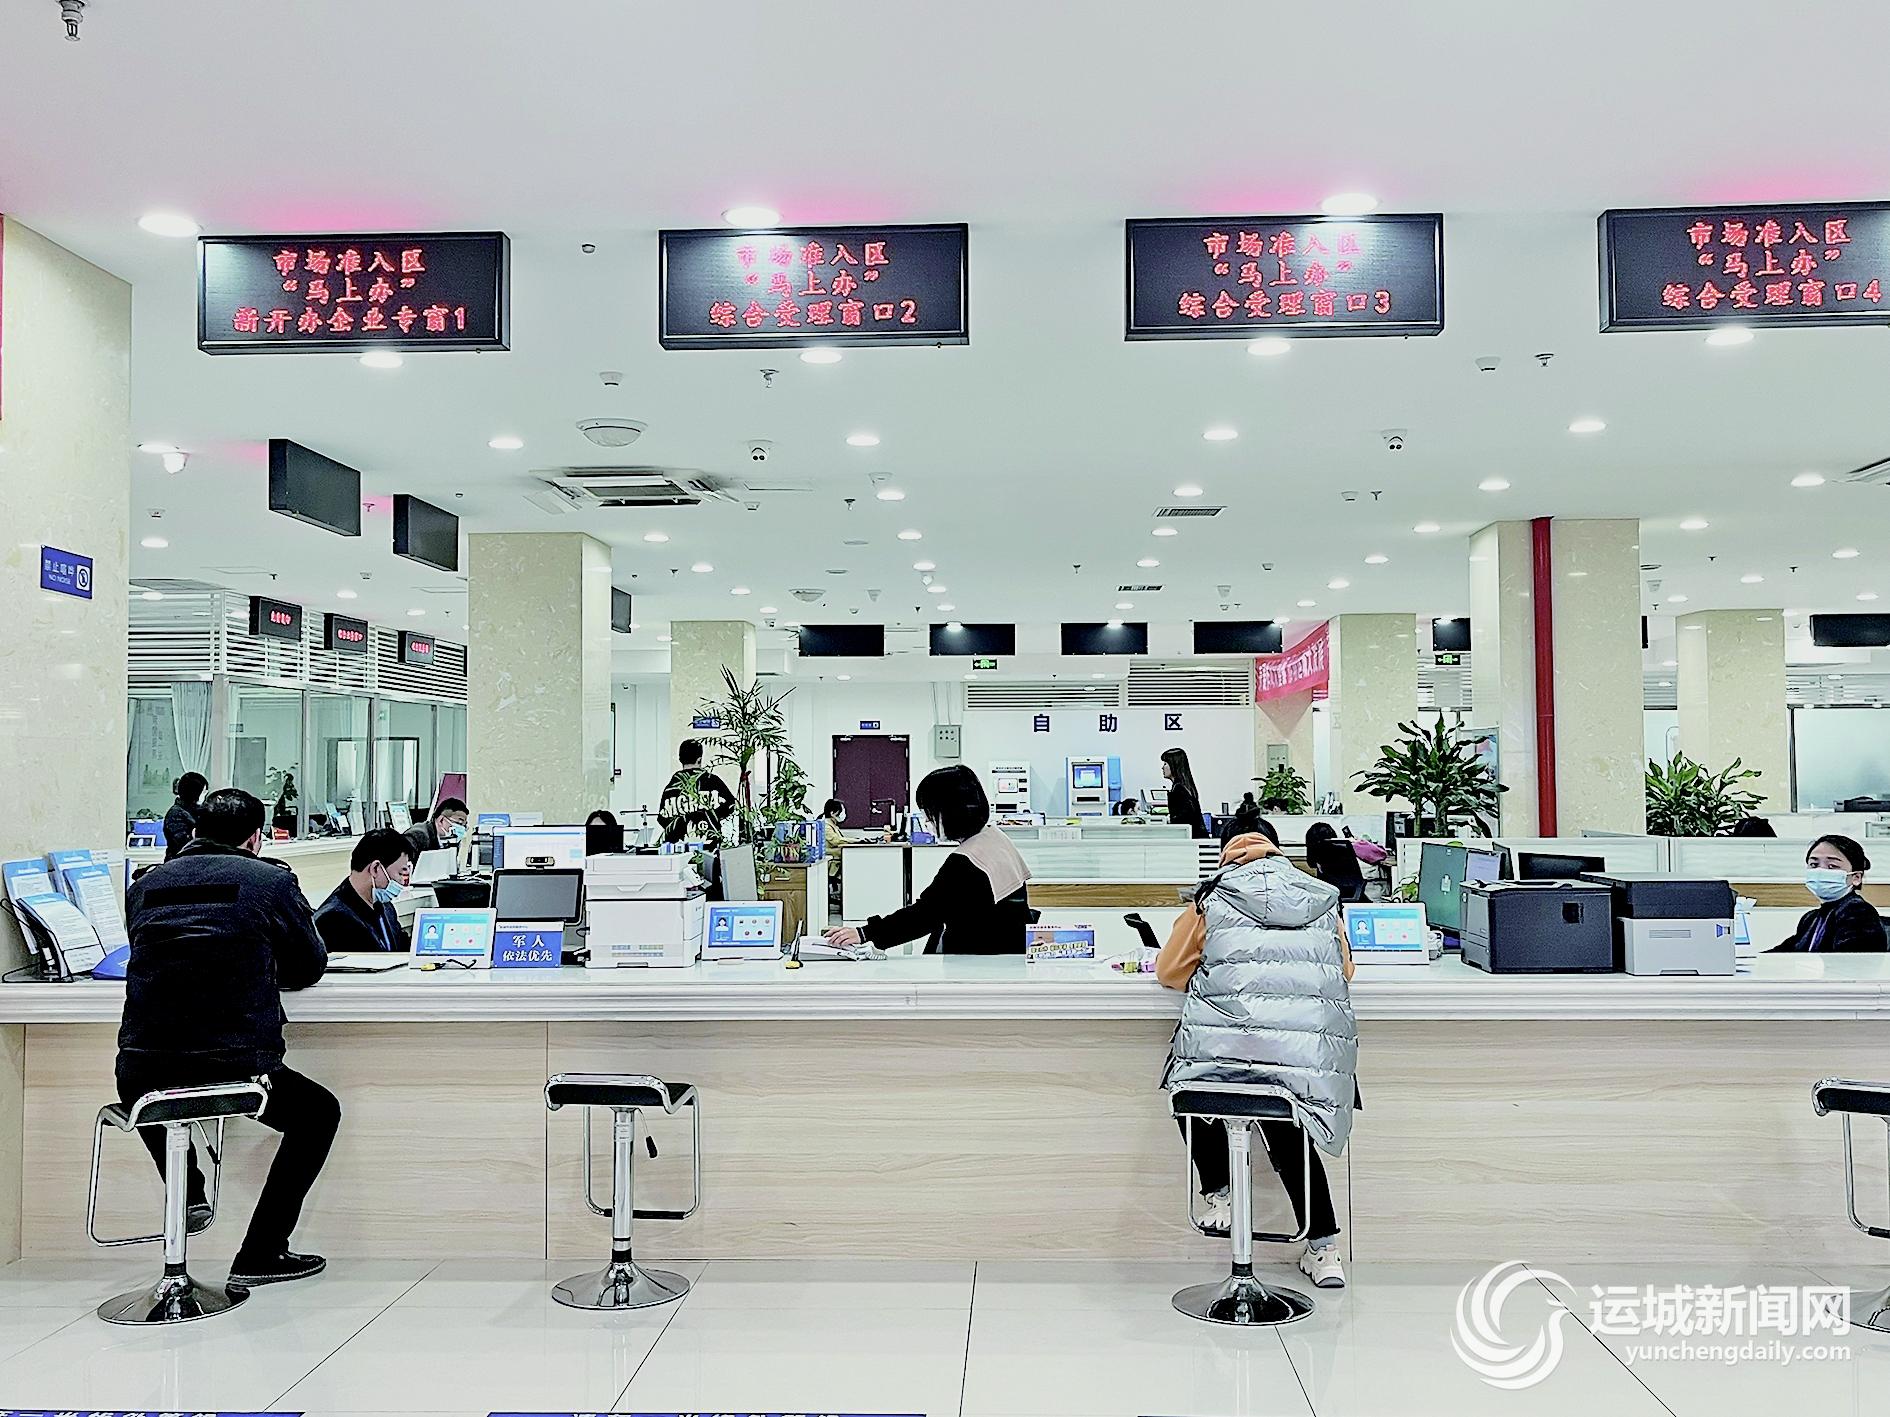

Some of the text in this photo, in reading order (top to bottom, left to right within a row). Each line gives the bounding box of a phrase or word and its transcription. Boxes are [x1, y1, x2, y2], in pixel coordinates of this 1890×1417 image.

[1203, 231, 1361, 259] 市场准入区
[1686, 219, 1851, 249] 市场准入区
[273, 249, 427, 276] 市场准入区
[735, 241, 890, 269] 市场准入区
[1177, 289, 1391, 318] 综合受理窗口3
[1661, 279, 1882, 310] 综合受理窗口4
[232, 306, 468, 333] 新开办企业专窗1
[709, 299, 917, 327] 综合受理窗口2
[1033, 713, 1184, 733] 自助区
[512, 934, 545, 949] 军人
[502, 949, 553, 963] 依法优先
